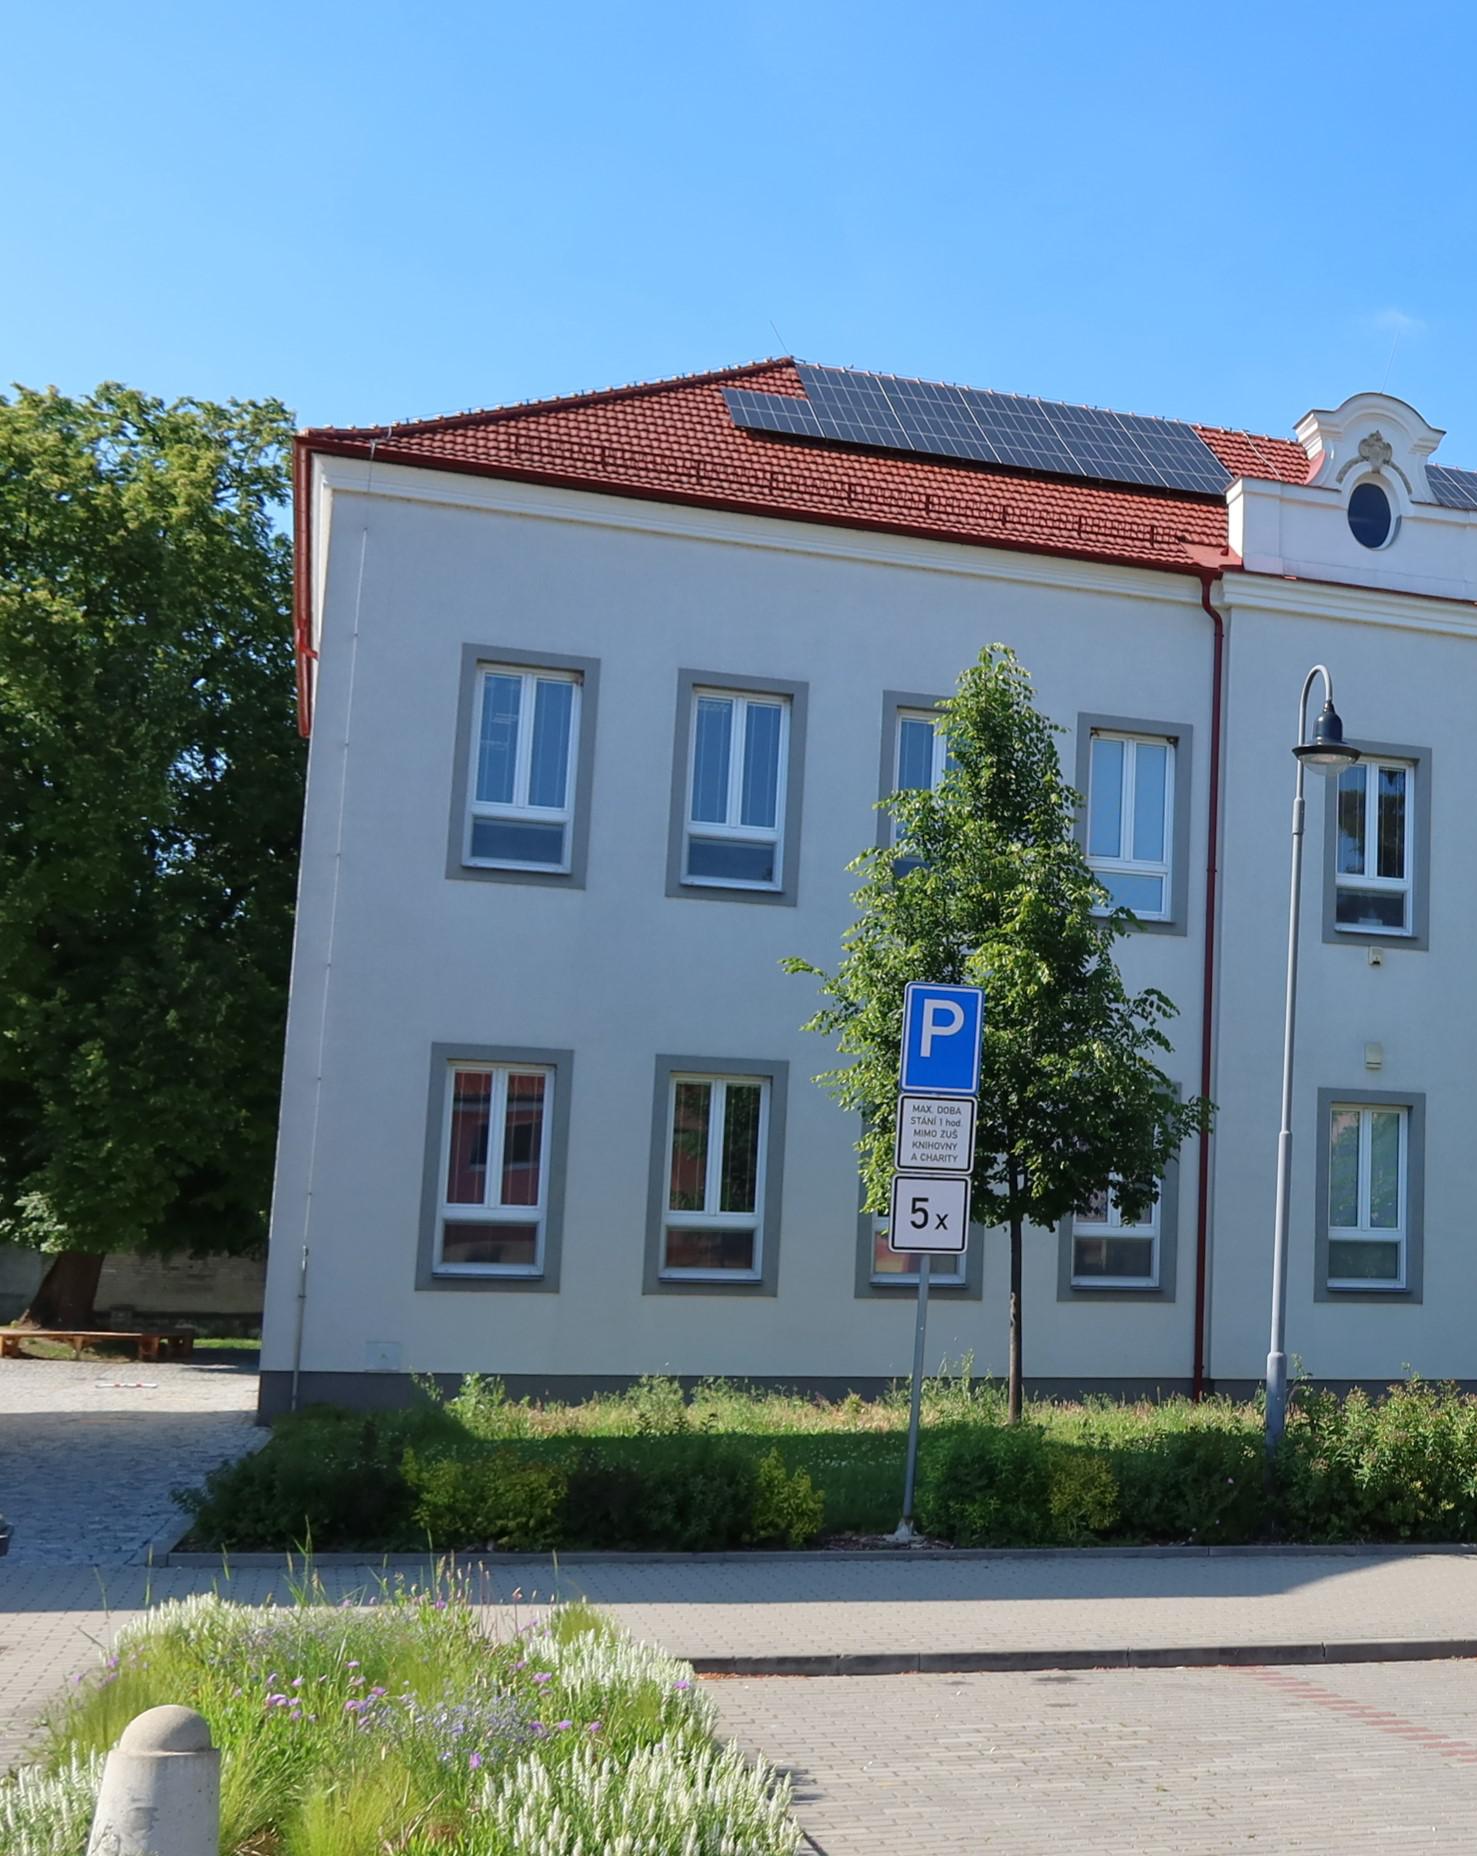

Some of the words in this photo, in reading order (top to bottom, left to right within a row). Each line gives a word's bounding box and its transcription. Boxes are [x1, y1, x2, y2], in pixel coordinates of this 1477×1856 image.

[920, 998, 964, 1057] P
[937, 1106, 962, 1115] DOBA
[939, 1118, 943, 1127] 1
[913, 1128, 938, 1138] MIMO
[940, 1129, 958, 1139] ZUŠ
[912, 1141, 958, 1151] KNIHOVNY
[910, 1153, 917, 1161] A
[920, 1153, 958, 1163] CHARITY
